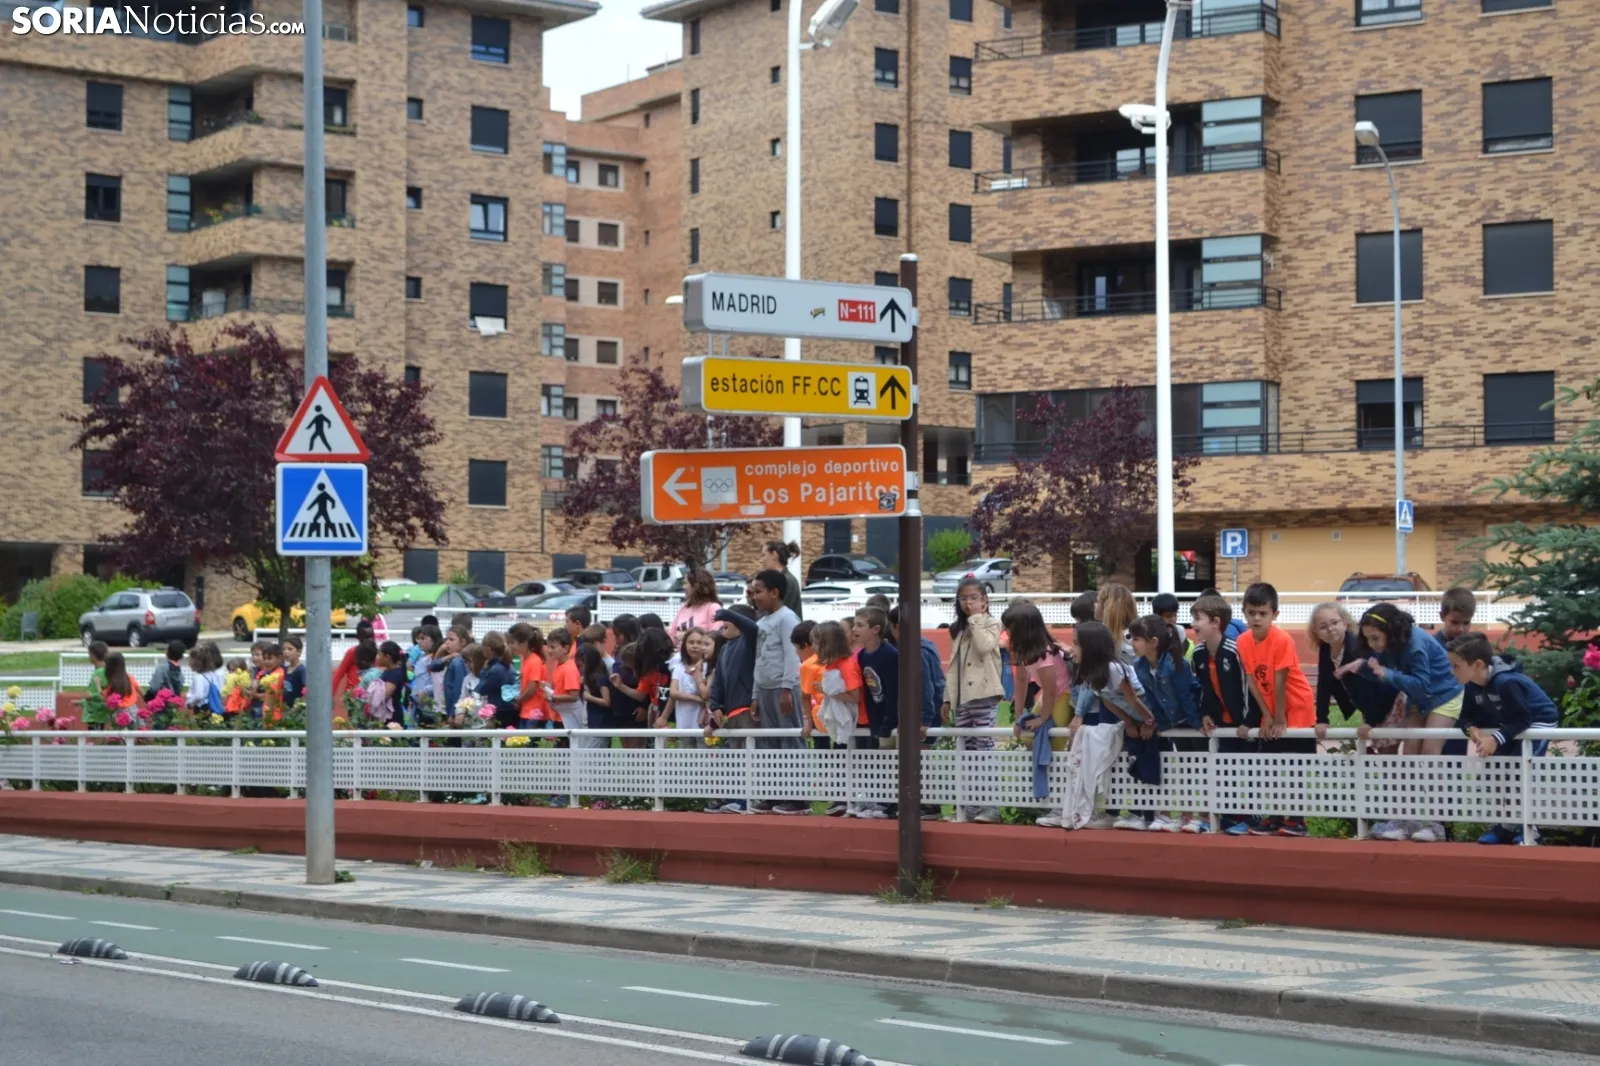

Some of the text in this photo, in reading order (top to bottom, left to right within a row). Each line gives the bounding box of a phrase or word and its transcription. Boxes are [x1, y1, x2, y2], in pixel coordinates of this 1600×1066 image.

[712, 290, 777, 315] MADRID
[840, 302, 875, 321] N-111
[710, 373, 841, 397] estación FF.CC
[744, 458, 899, 478] complejo deportivo
[748, 483, 790, 504] Los
[1226, 532, 1242, 554] P
